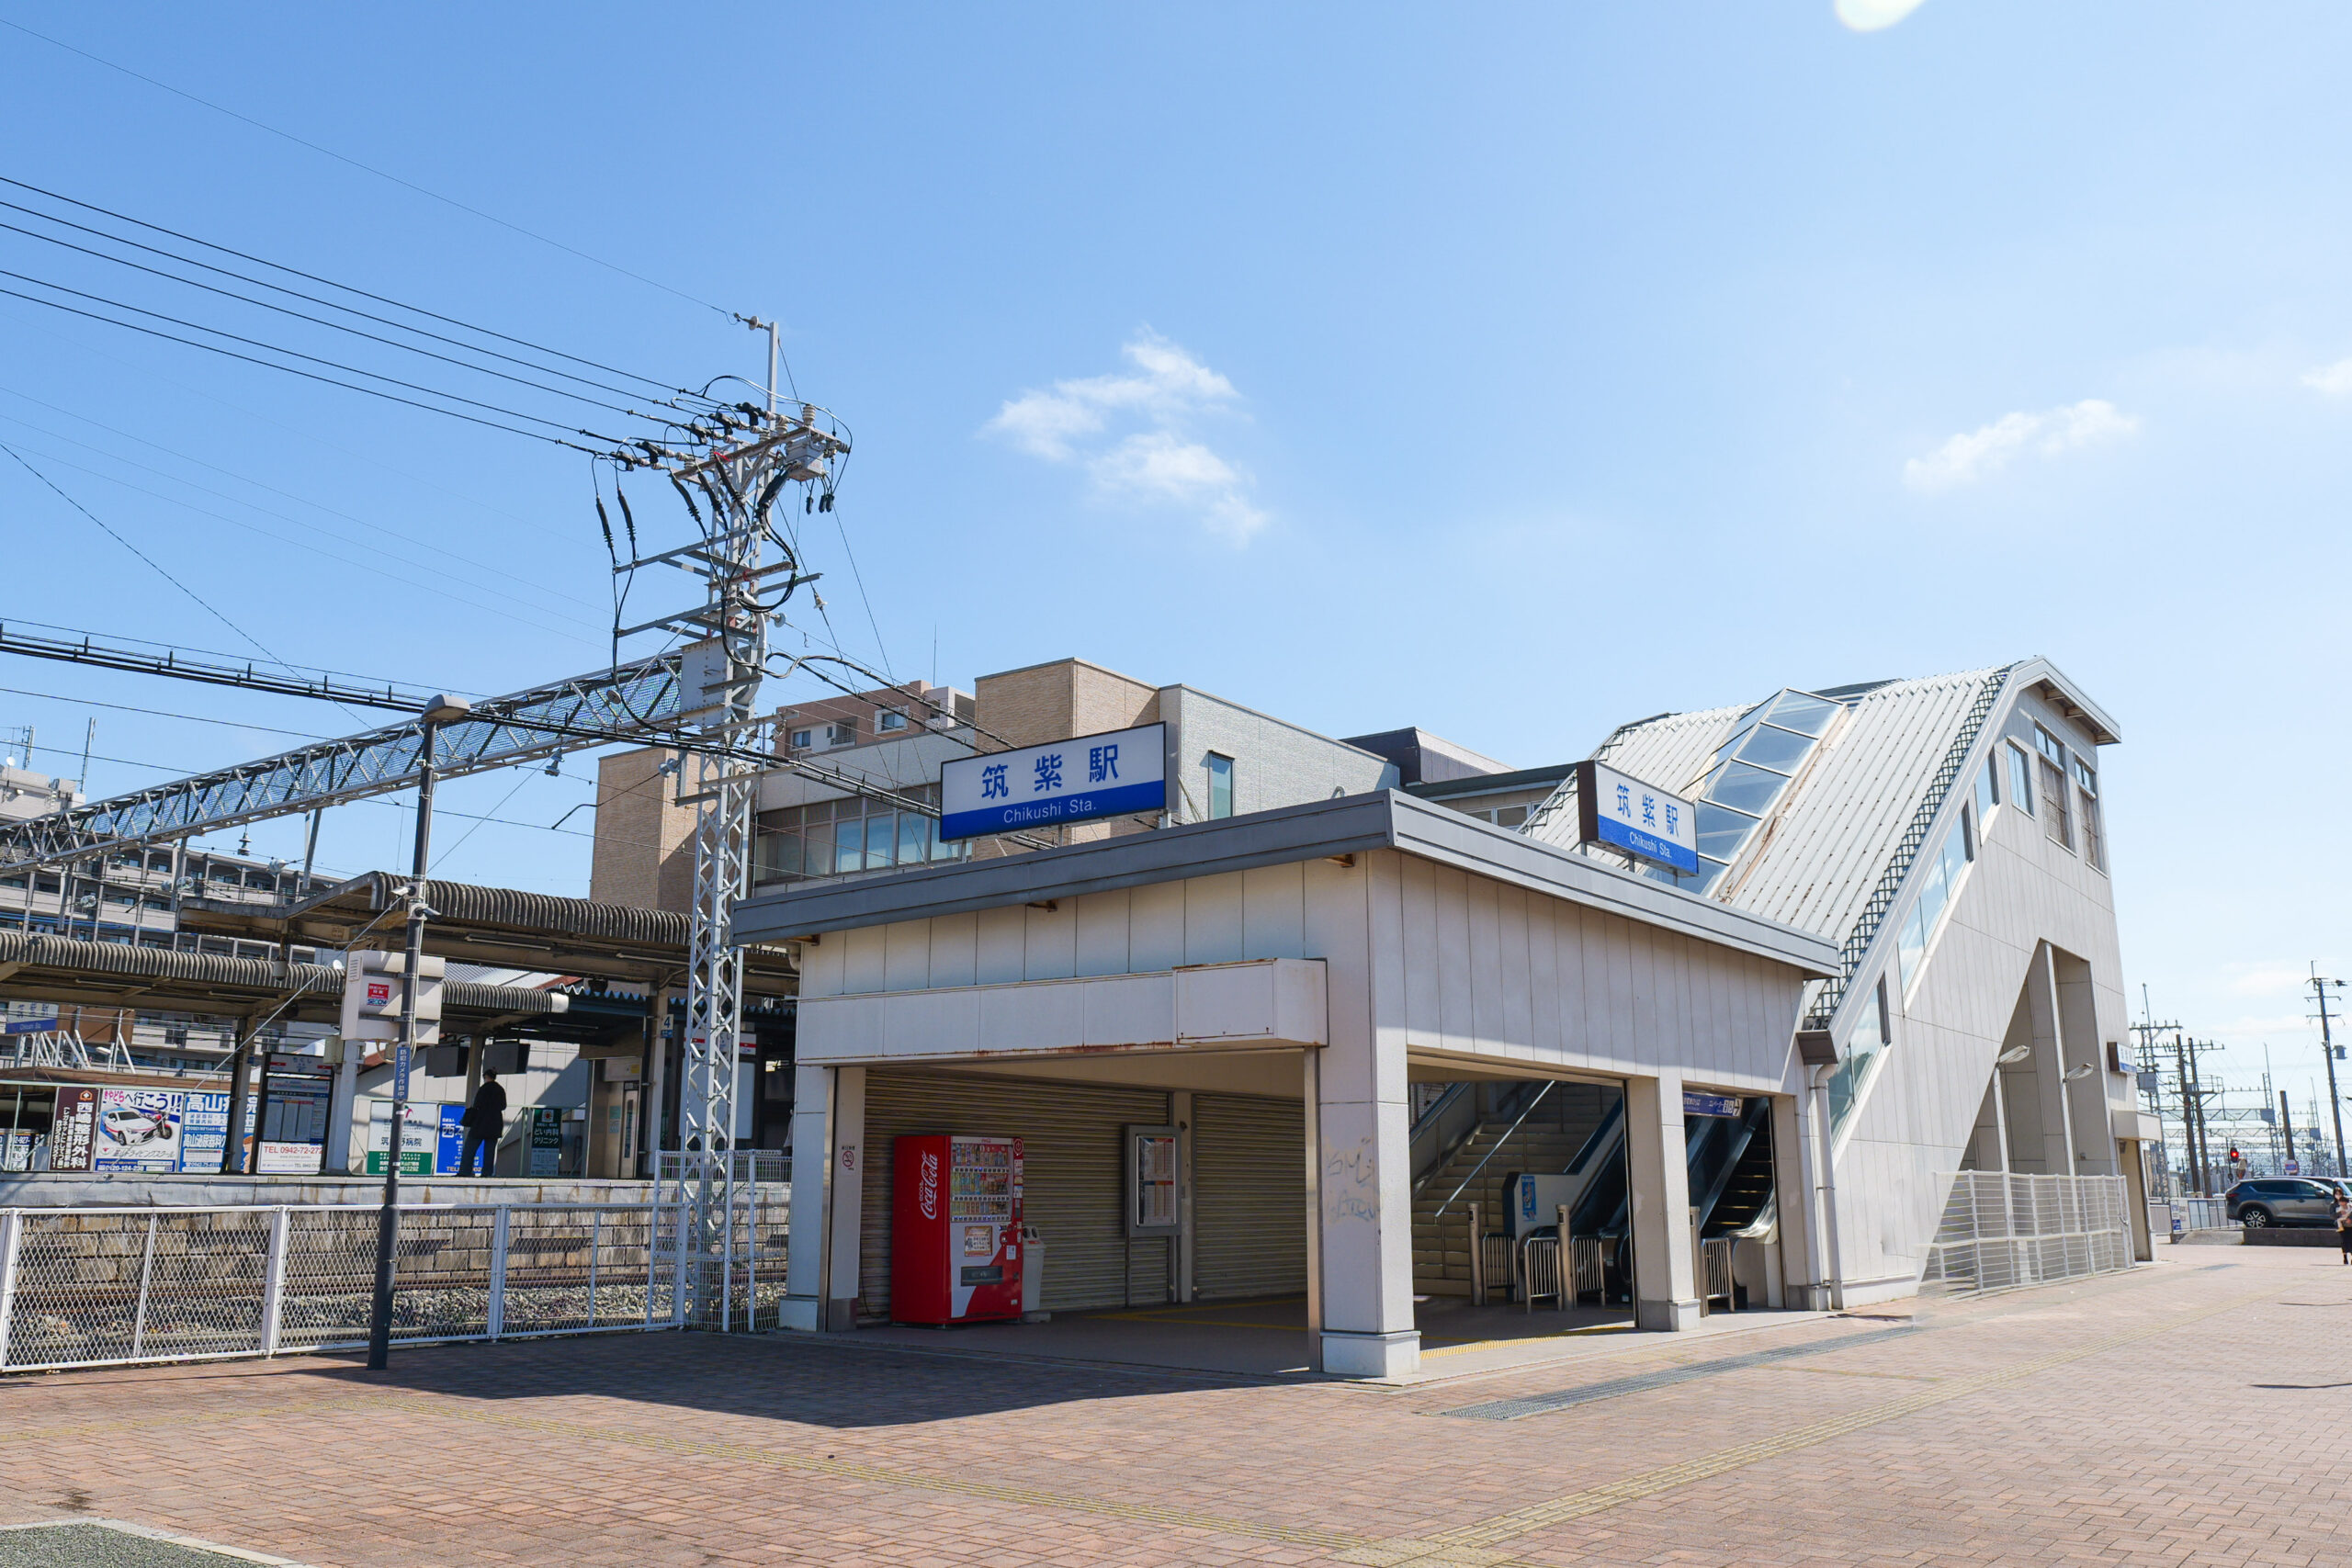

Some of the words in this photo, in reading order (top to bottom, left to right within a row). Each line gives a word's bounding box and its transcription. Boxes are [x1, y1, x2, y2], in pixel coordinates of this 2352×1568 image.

[981, 743, 1119, 800] 筑紫駅
[1003, 801, 1062, 824] Chikushi
[1069, 798, 1097, 814] Sta.
[1616, 783, 1679, 838] 筑紫駅
[1629, 831, 1657, 853] Chikushi
[1659, 842, 1672, 859] Sta.
[664, 1016, 671, 1028] 4
